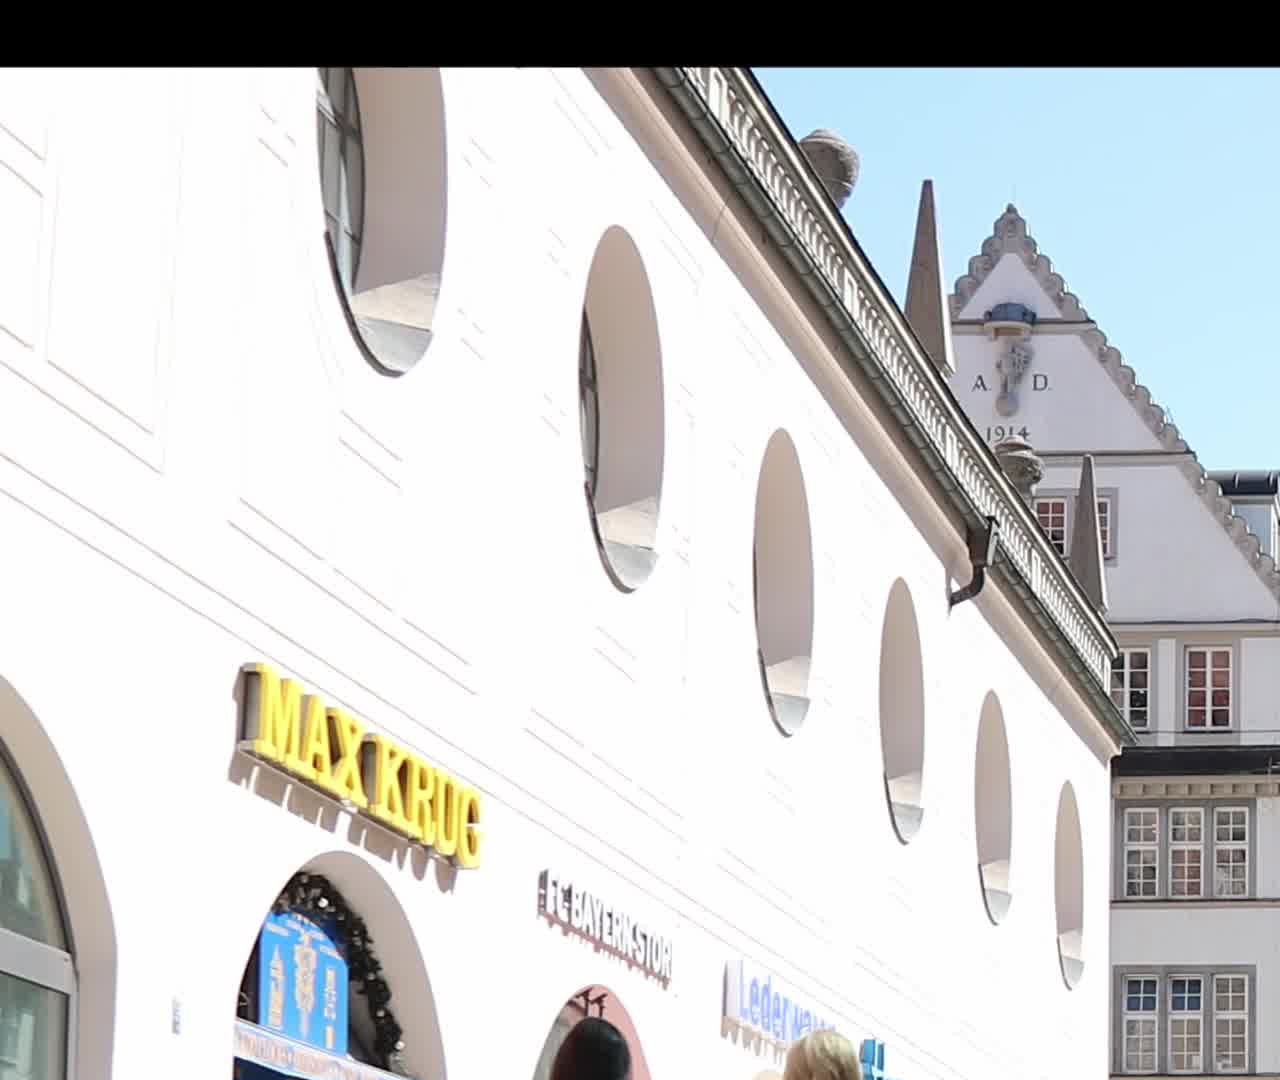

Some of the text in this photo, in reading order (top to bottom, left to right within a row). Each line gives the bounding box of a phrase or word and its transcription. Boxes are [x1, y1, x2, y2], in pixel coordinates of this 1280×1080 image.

[986, 425, 1030, 441] 1914
[244, 661, 482, 869] MAX KRUG
